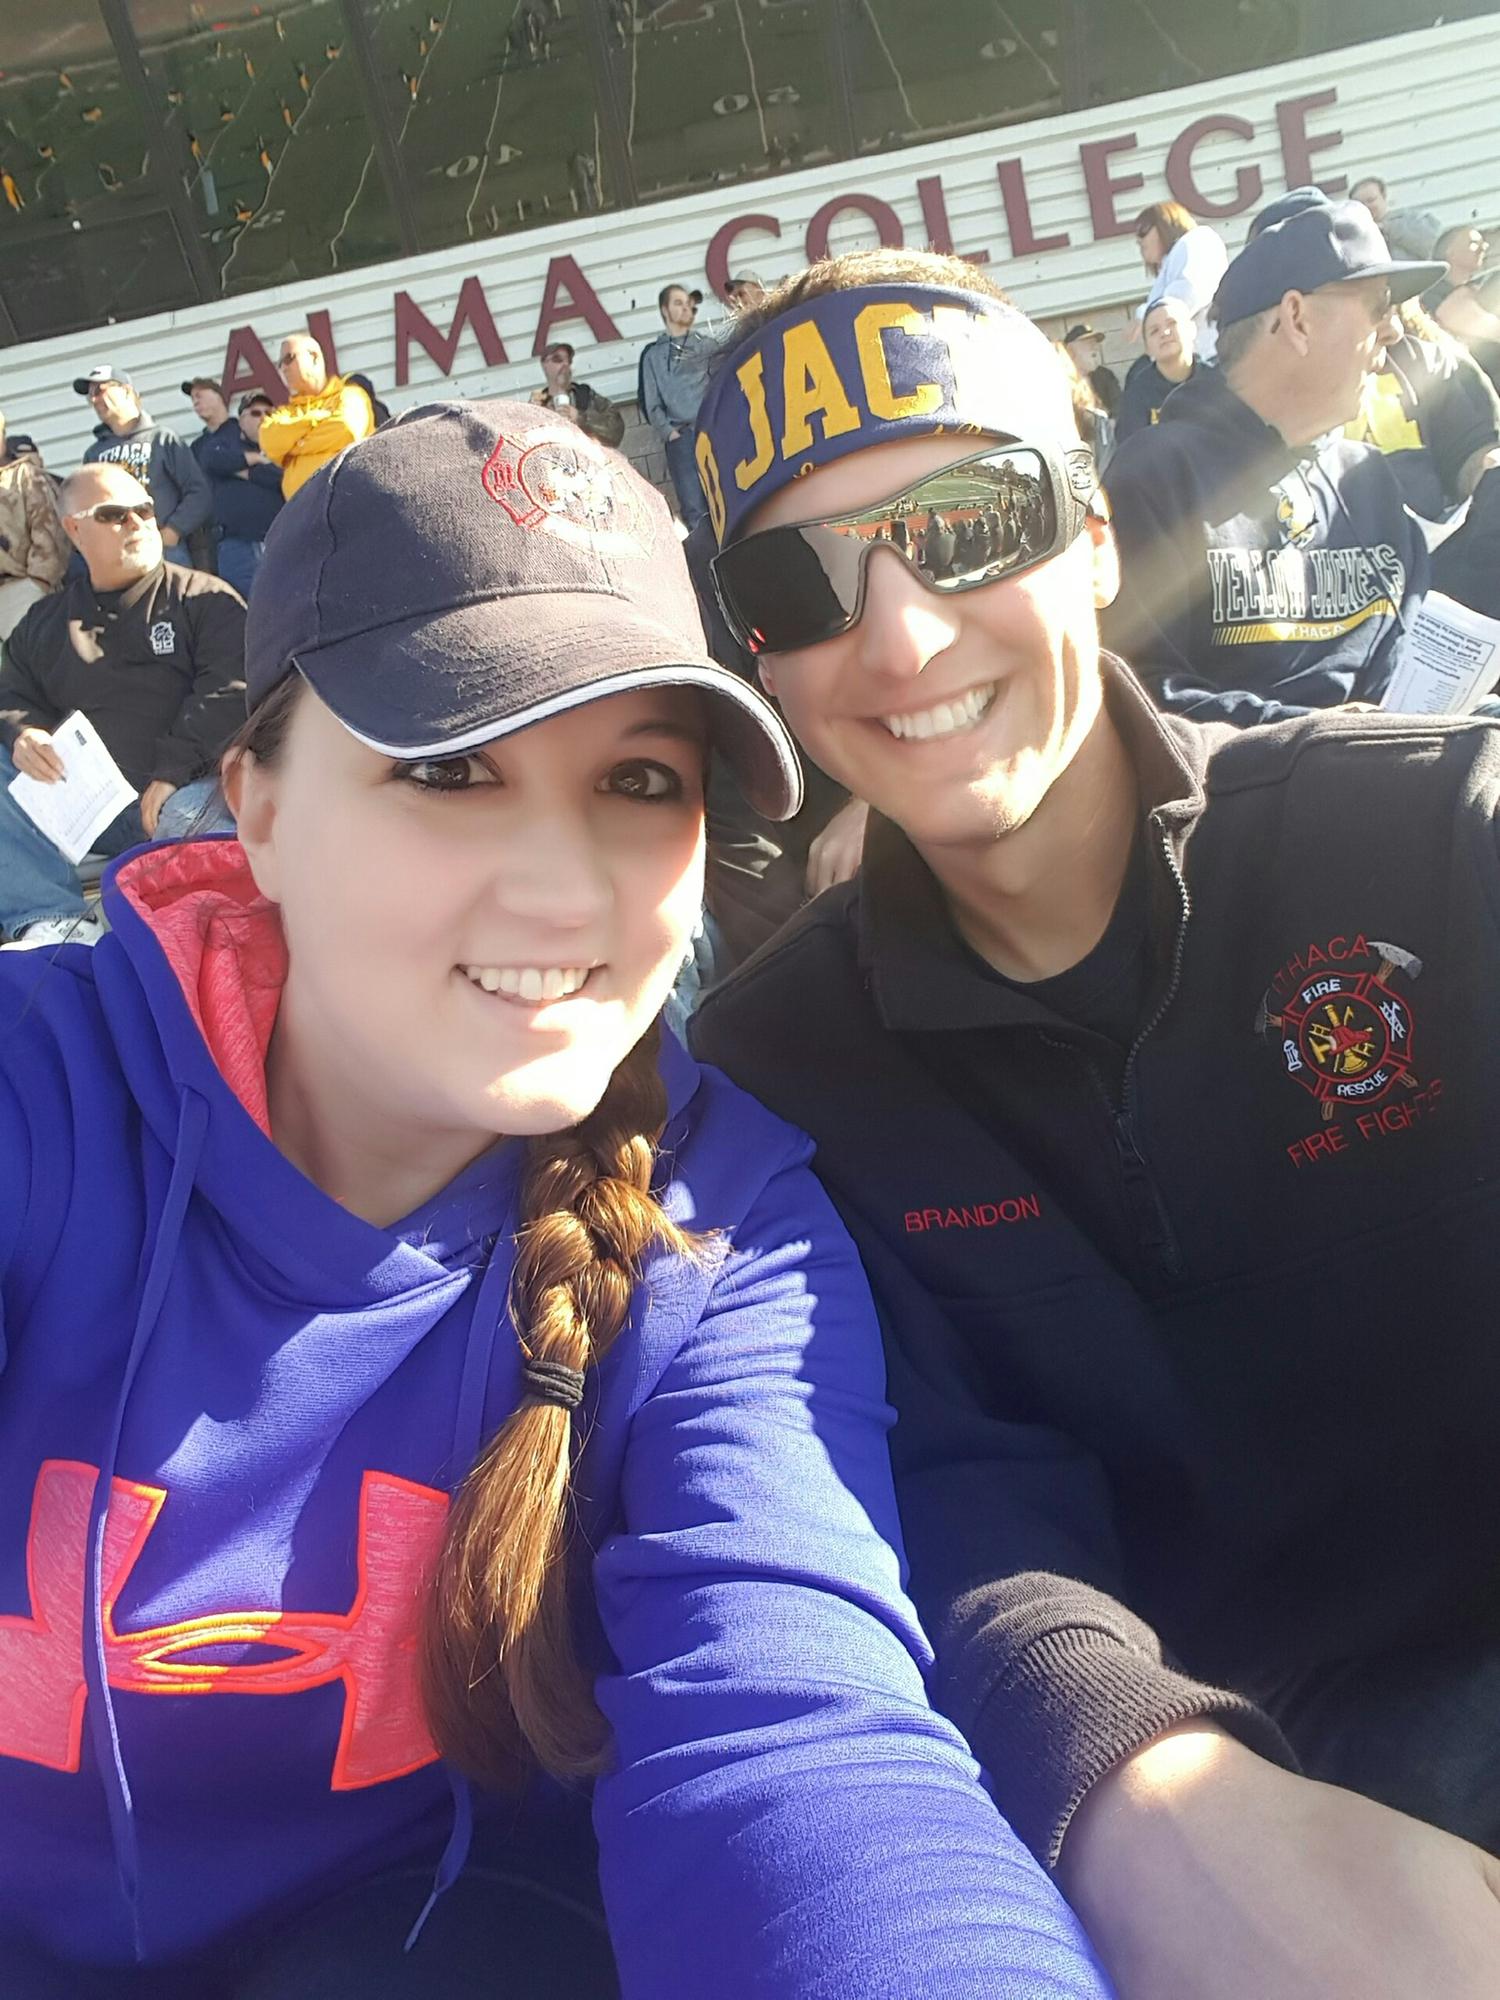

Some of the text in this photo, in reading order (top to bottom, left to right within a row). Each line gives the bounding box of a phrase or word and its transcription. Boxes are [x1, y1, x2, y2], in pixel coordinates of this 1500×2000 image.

[221, 88, 1348, 408] ALMA COLLEGE
[1206, 547, 1306, 623] YELLOW
[1284, 622, 1345, 639] THACA
[1273, 934, 1370, 993] ITHACA
[1302, 978, 1342, 1004] FIRE
[1337, 1070, 1389, 1097] RESCUE
[1287, 1126, 1349, 1169] FIRE
[904, 1193, 1041, 1233] BRANDON
